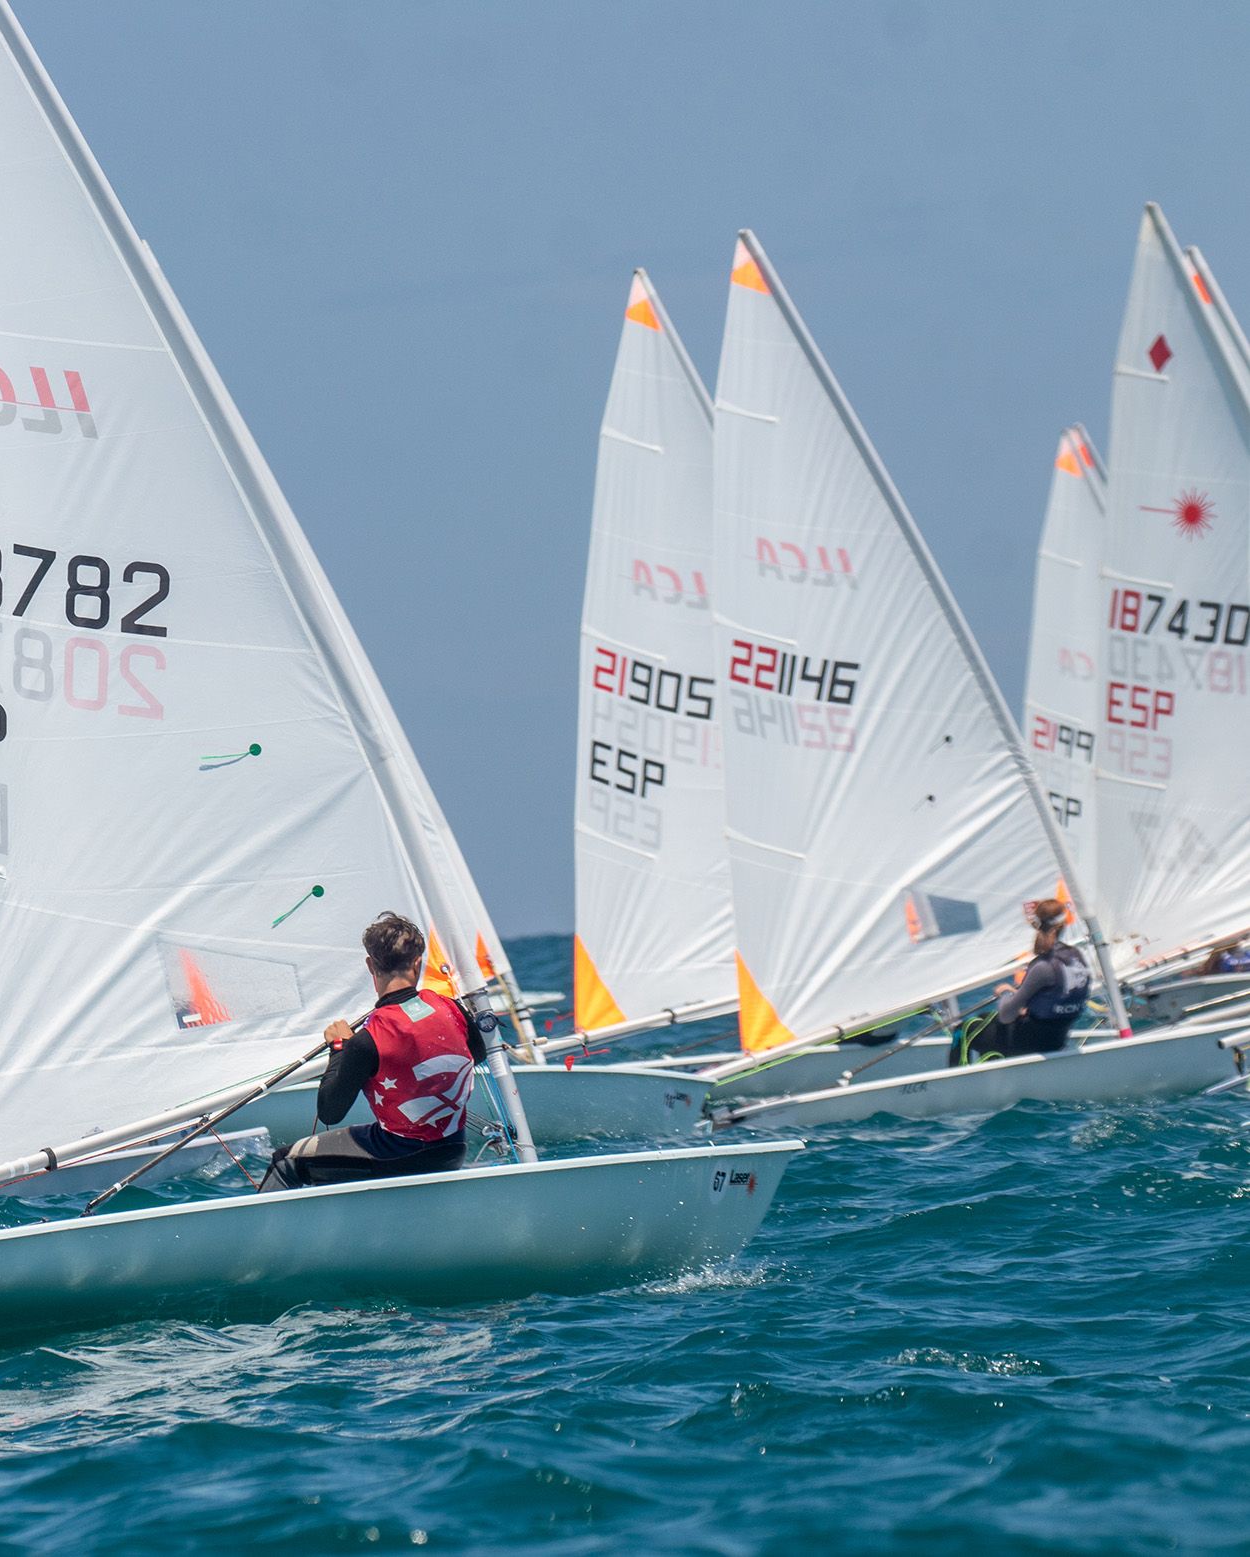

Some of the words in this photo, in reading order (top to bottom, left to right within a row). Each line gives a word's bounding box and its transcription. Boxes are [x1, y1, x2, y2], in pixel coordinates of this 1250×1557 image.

[1109, 588, 1250, 646] 187430
[592, 646, 715, 721] 21905
[729, 639, 860, 706] 221146
[1106, 682, 1176, 731] ESP
[589, 739, 667, 799] ESP
[1049, 791, 1082, 829] SP
[729, 1170, 750, 1184] Laser
